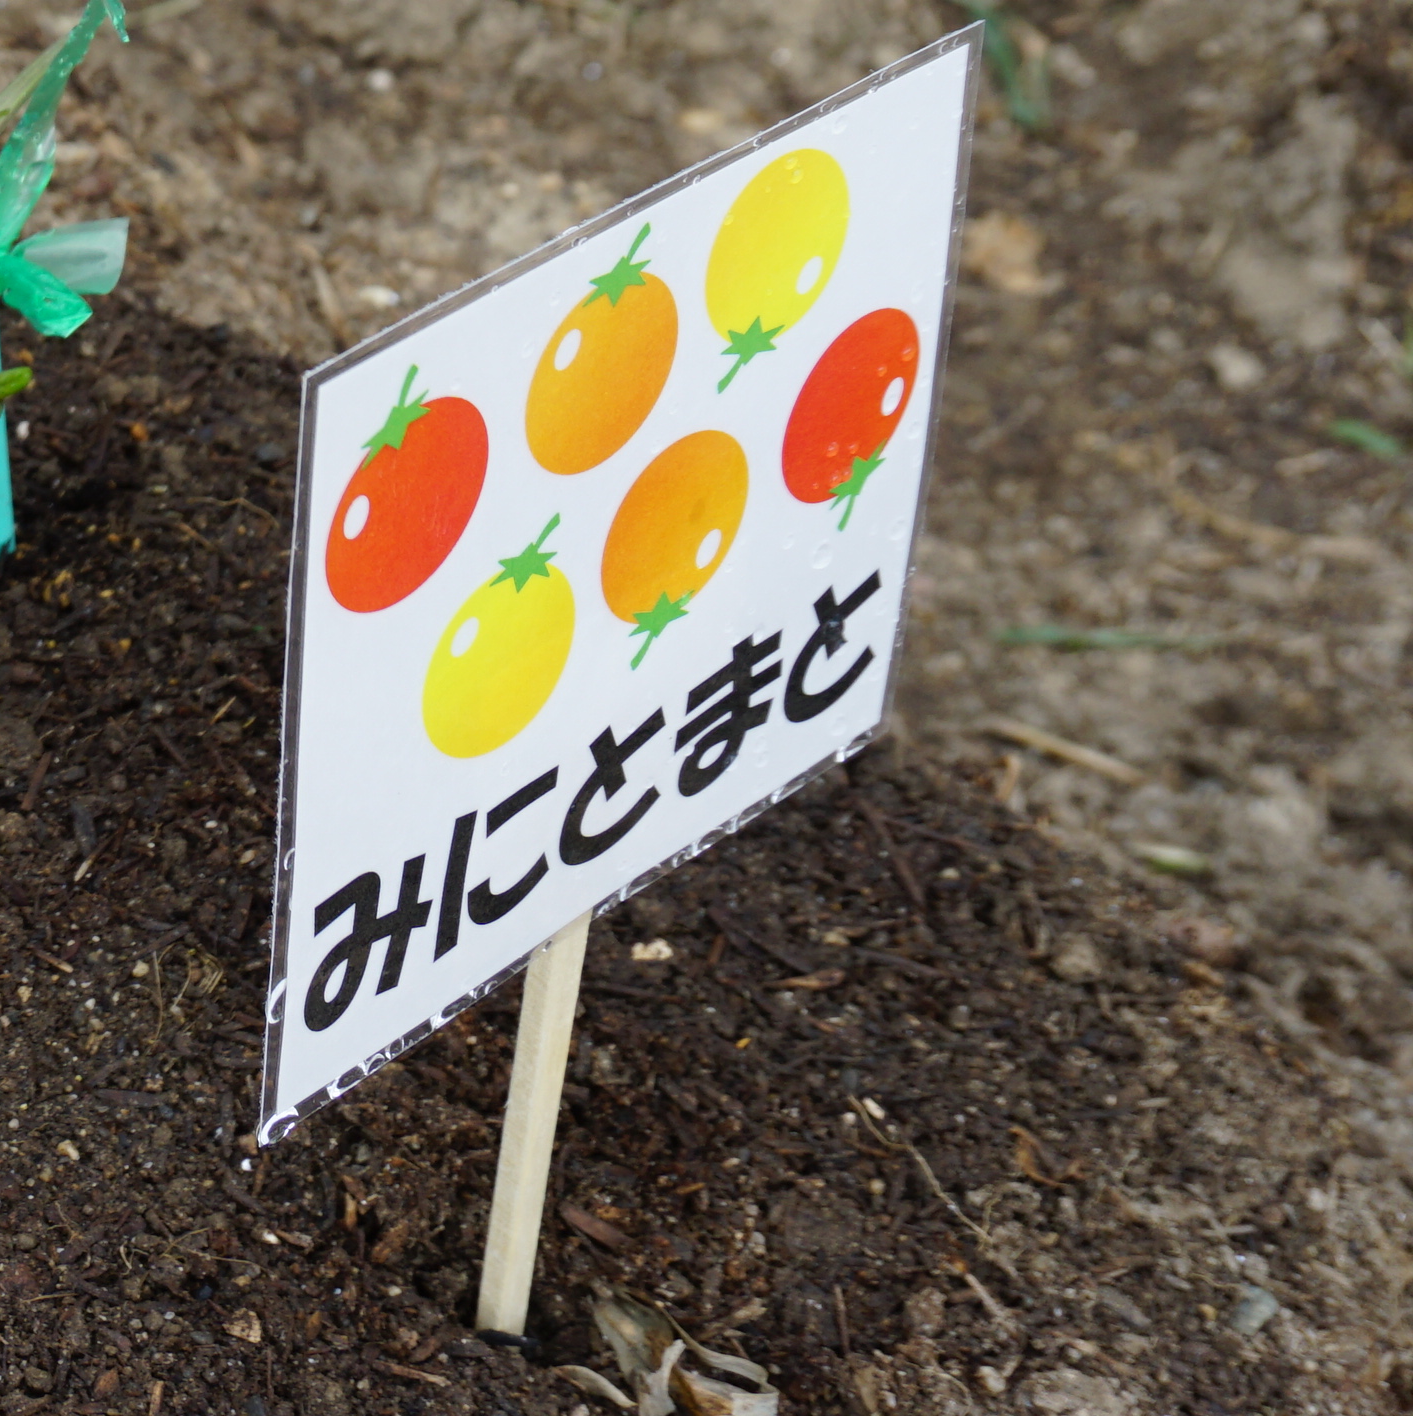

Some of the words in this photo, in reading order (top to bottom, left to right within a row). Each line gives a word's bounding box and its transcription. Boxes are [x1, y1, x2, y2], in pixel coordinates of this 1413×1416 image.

[304, 570, 881, 1032] みにとまと
